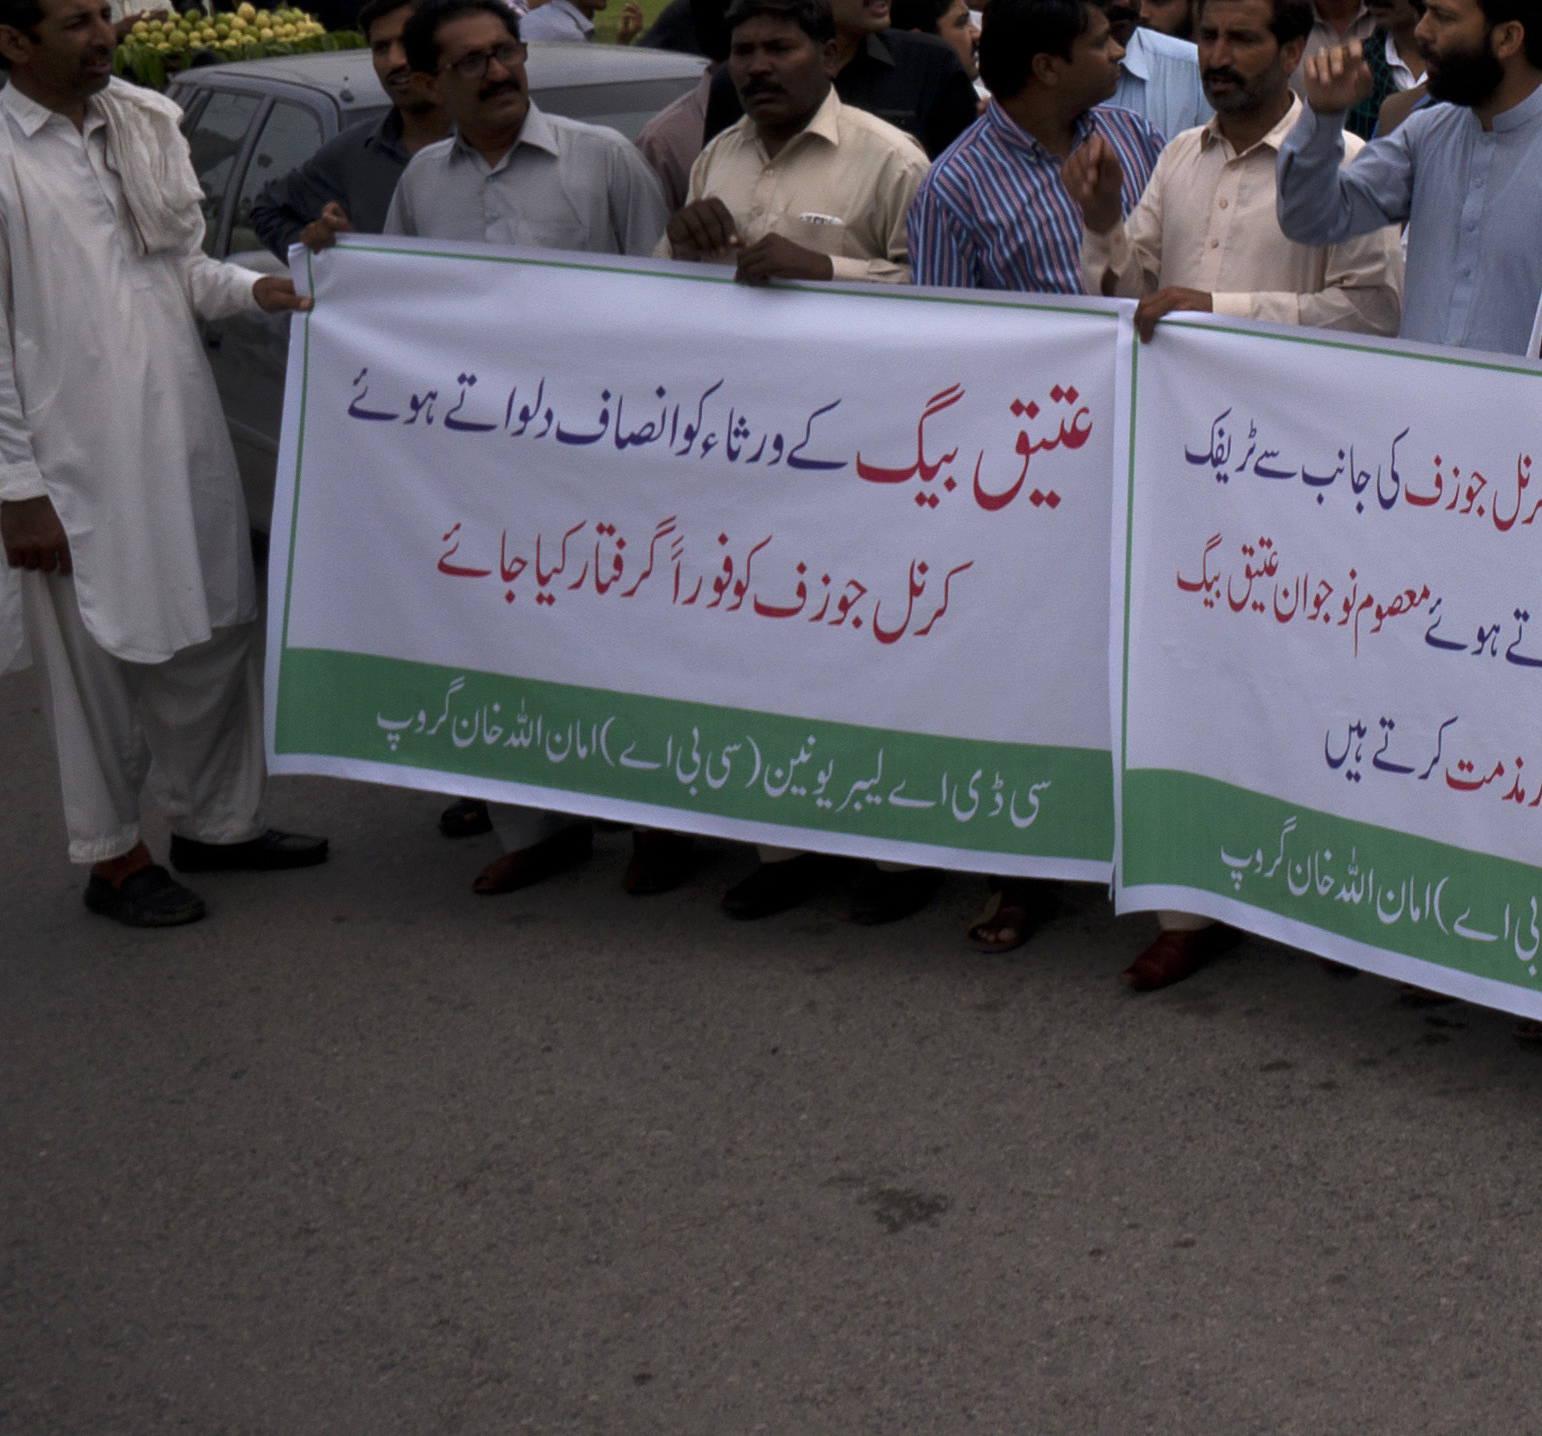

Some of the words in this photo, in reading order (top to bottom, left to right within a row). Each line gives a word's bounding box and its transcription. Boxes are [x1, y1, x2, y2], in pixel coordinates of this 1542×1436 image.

[347, 367, 438, 425] ہوئے
[555, 385, 680, 450] انصاف
[675, 379, 724, 456] کو
[786, 399, 848, 471] کے
[855, 383, 965, 510] بیگ
[972, 384, 1093, 512] عتیق
[1253, 450, 1297, 480] سے
[1376, 428, 1410, 511] کی
[1301, 448, 1371, 514] جانب
[1404, 455, 1488, 518] جوزف
[436, 522, 528, 604] جائے
[535, 520, 586, 607] کیا
[567, 515, 677, 598] گرفتار
[726, 535, 772, 612] کو
[1176, 533, 1222, 609] بیگ
[1227, 536, 1279, 613] عتیق
[753, 561, 868, 629] جوزف
[872, 560, 974, 645] کرنل
[1354, 584, 1431, 657] معصوم
[1324, 720, 1367, 783] ہیں
[1371, 716, 1459, 781] کرتے
[1445, 756, 1526, 804] مذمت
[888, 773, 948, 809] اے
[1009, 781, 1051, 829] سی
